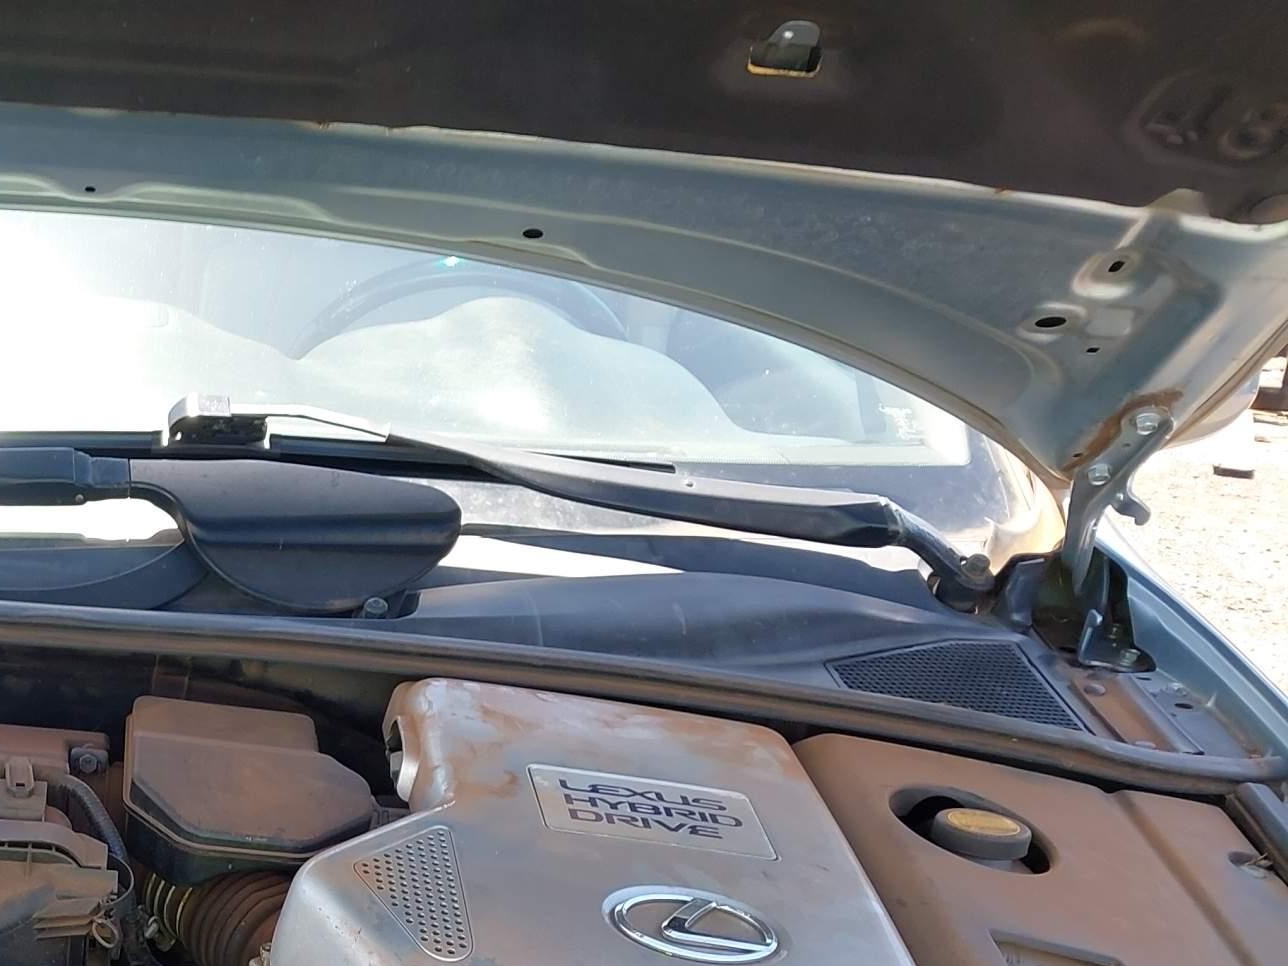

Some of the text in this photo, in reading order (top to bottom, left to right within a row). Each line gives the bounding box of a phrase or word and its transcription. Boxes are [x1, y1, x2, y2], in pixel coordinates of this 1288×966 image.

[559, 778, 728, 811] LEXUS
[565, 793, 743, 828] HYBRID
[568, 807, 723, 840] DRIVE
